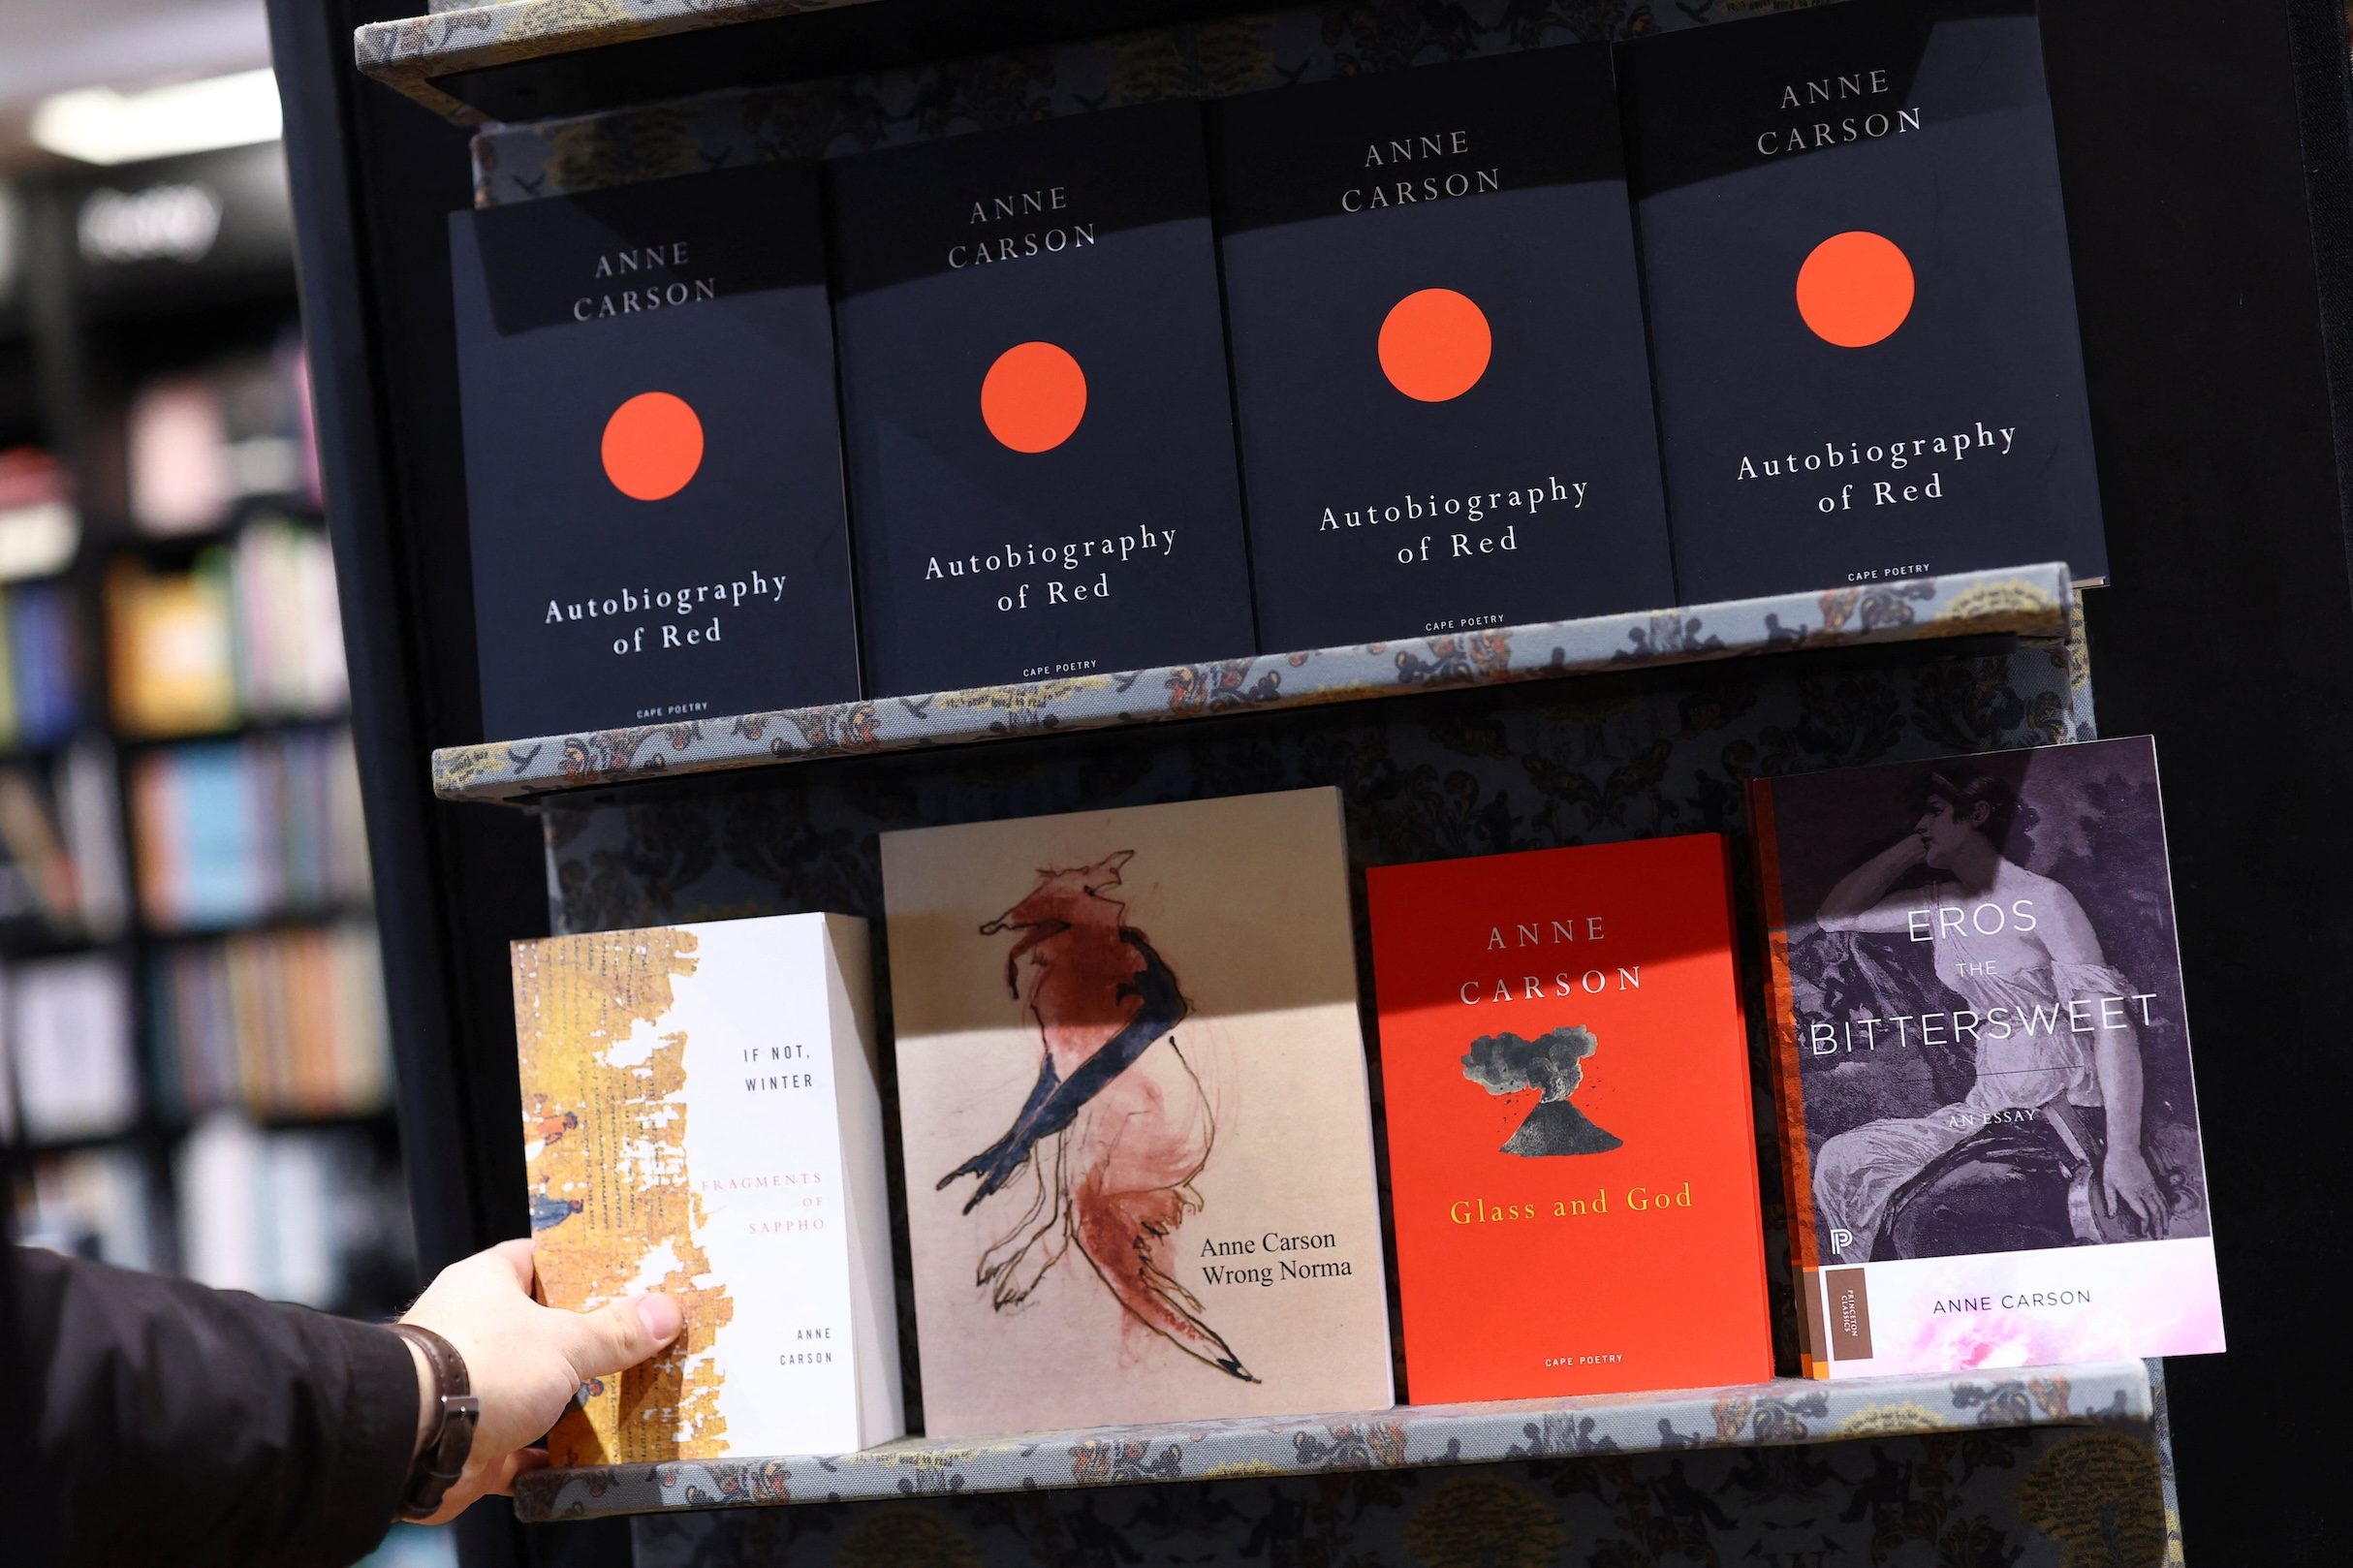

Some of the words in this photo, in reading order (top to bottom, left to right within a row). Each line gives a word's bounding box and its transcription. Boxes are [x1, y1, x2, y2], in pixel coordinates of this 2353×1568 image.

[1781, 70, 1888, 109] ANNE
[1365, 131, 1467, 167] ANNE
[1758, 108, 1920, 154] CARSON
[971, 187, 1066, 224] ANNE
[1342, 169, 1497, 212] CARSON
[595, 241, 688, 279] ANNE
[949, 224, 1094, 267] CARSON
[574, 278, 715, 321] CARSON
[1738, 423, 2015, 480] Autobiography
[1320, 477, 1587, 531] Autobiography
[1819, 485, 1853, 513] of
[1873, 473, 1942, 505] Red
[926, 524, 1176, 580] Autobiography
[1398, 536, 1430, 563] of
[1451, 525, 1517, 557] Red
[1848, 570, 1877, 581] CAPE
[1884, 564, 1929, 577] POETRY
[546, 571, 785, 623] Autobiography
[998, 584, 1028, 611] of
[1048, 573, 1109, 604] Red
[613, 627, 643, 654] of
[662, 617, 720, 647] Red
[1426, 620, 1454, 631] CAPE
[1460, 614, 1503, 627] POETRY
[1023, 666, 1050, 676] CAPE
[1056, 660, 1096, 673] POETRY
[636, 706, 663, 719] CAPE
[668, 702, 707, 714] POETRY
[1488, 917, 1604, 950] ANNE
[1907, 899, 2037, 943] EROS
[1459, 965, 1643, 1005] CARSON
[1955, 959, 1998, 978] THE
[1809, 993, 2157, 1055] BITTERSWEET
[744, 1049, 758, 1062] IF
[772, 1045, 811, 1061] NOT,
[745, 1074, 811, 1091] WINTER
[1948, 1113, 1975, 1128] AN
[1983, 1109, 2037, 1125] ESSAY
[701, 1172, 822, 1192] FRAGMENTS
[802, 1196, 823, 1207] OF
[1450, 1198, 1536, 1225] Glass
[1553, 1188, 1609, 1217] and
[1626, 1180, 1693, 1211] God
[749, 1218, 825, 1234] SAPPHO
[1201, 1237, 1257, 1258] Anne
[1262, 1232, 1336, 1252] Carson
[1201, 1265, 1274, 1287] Wrong
[1278, 1259, 1353, 1280] Norma
[1841, 1295, 1852, 1333] CLASSICS
[1847, 1288, 1859, 1337] PRINCETON
[1932, 1296, 1992, 1314] ANNE
[2001, 1290, 2091, 1309] CARSON
[797, 1328, 831, 1340] ANNE
[779, 1352, 832, 1365] CARSON
[1545, 1357, 1574, 1367] CAPE
[1579, 1354, 1623, 1365] POETRY
